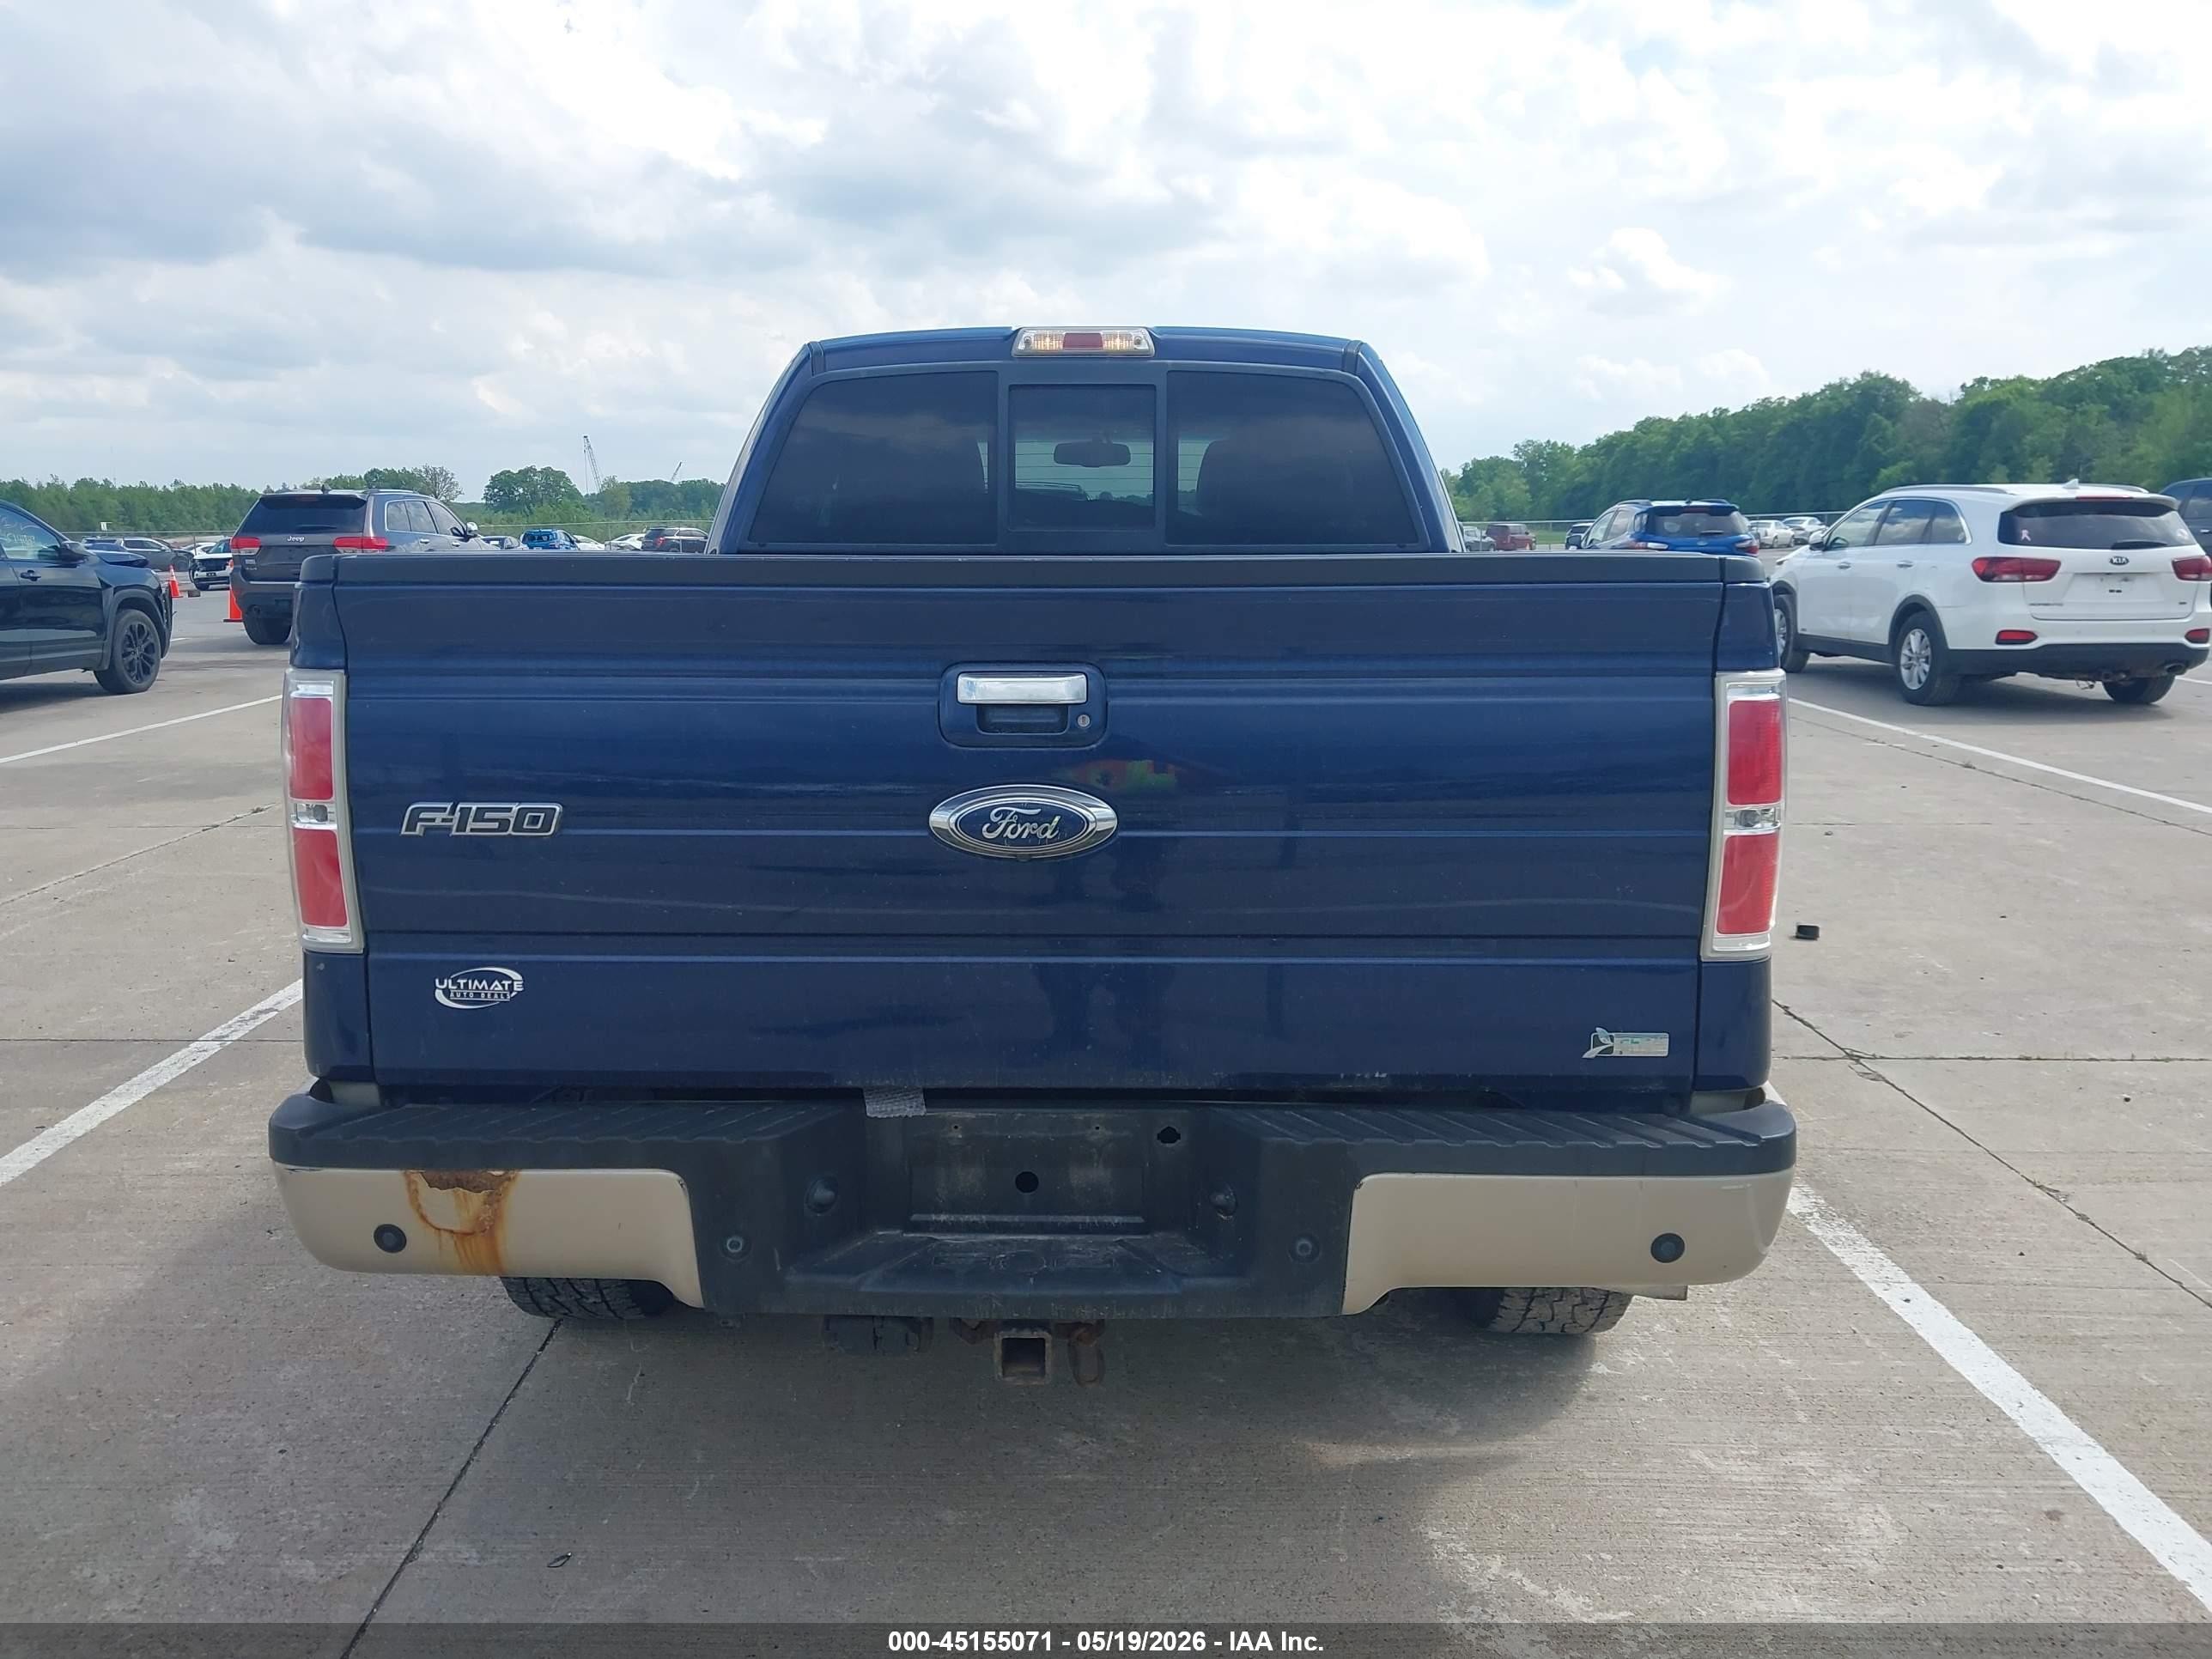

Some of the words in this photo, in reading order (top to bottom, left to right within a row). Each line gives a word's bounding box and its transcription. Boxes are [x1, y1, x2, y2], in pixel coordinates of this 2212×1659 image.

[400, 803, 562, 836] F-150
[981, 806, 1061, 839] Ford
[434, 978, 524, 992] ULTIMATE
